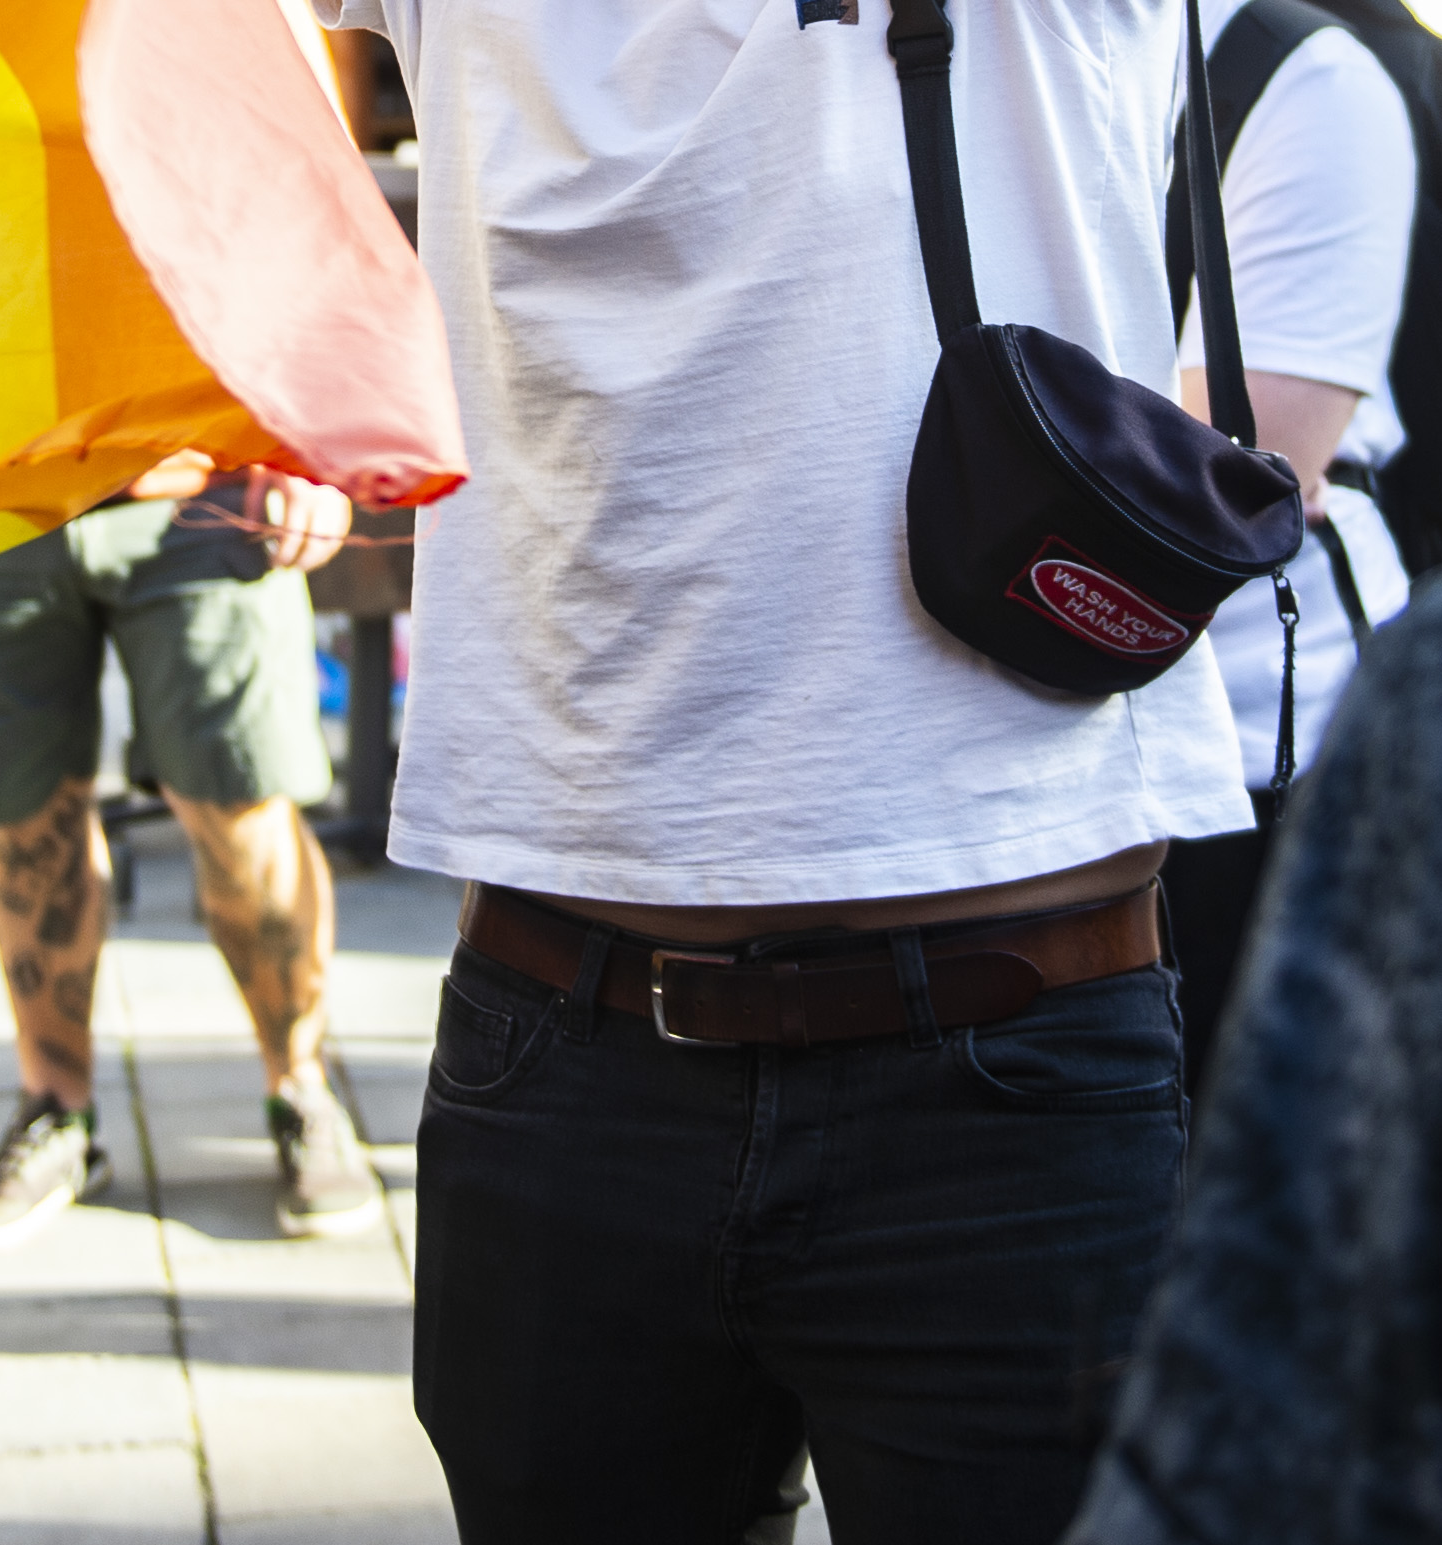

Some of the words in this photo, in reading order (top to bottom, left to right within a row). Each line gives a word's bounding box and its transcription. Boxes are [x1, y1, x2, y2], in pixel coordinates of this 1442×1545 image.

[1052, 567, 1118, 615] WASH
[1122, 610, 1177, 642] YOUR
[1064, 597, 1142, 646] HANDS
